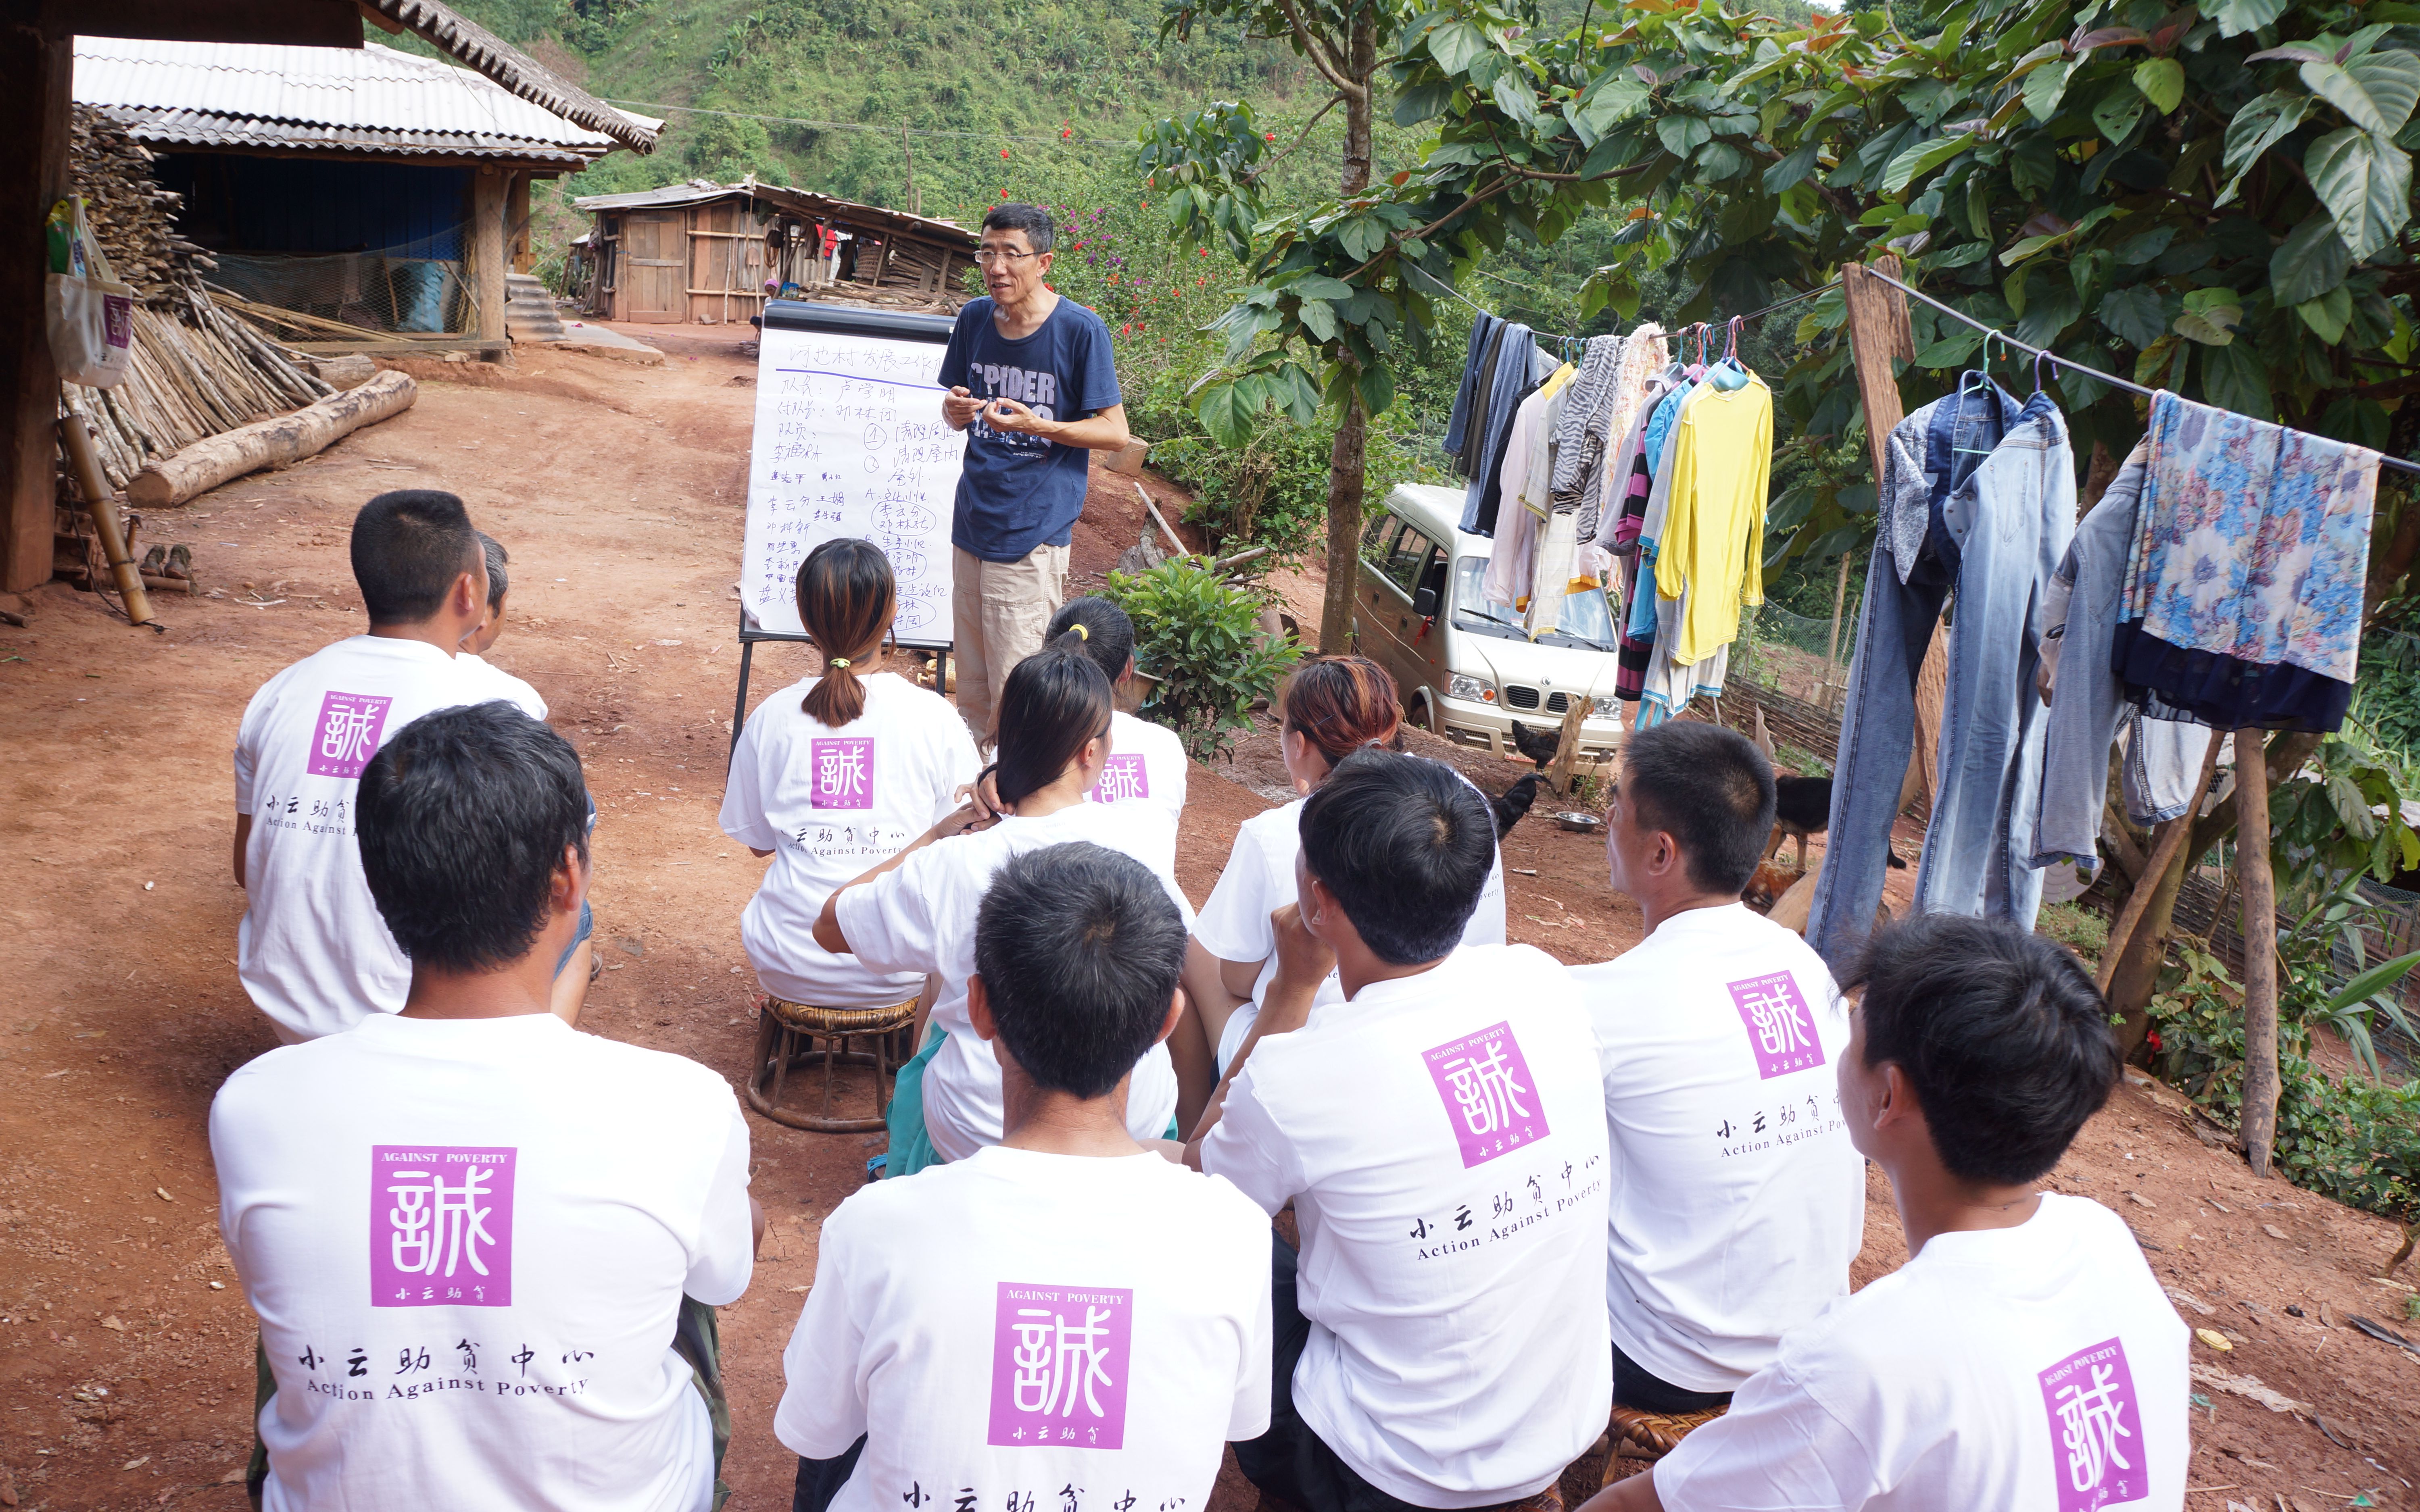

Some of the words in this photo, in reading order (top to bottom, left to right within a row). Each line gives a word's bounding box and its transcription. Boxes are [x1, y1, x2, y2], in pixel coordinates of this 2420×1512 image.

[970, 362, 1056, 405] SPIDER
[266, 817, 297, 829] Action
[302, 821, 346, 834] Against
[811, 847, 855, 857] Against
[1479, 888, 1499, 900] overty
[1733, 981, 1759, 992] AGAINST
[1761, 974, 1789, 985] POVERTY
[1430, 1043, 1465, 1062] AGAINST
[1468, 1027, 1506, 1048] POVERTY
[1720, 1141, 1770, 1158] Action
[1776, 1124, 1823, 1146] Against
[381, 1152, 439, 1163] AGAINST
[446, 1153, 508, 1164] POVERTY
[1410, 1155, 1599, 1239] 小云助贫中心
[1417, 1238, 1481, 1261] Action
[1489, 1206, 1549, 1243] Against
[1556, 1178, 1601, 1212] Poverty
[1006, 1290, 1060, 1302] AGAINST
[1066, 1293, 1124, 1305] POVERTY
[298, 1338, 595, 1378] 小云助贫中心
[306, 1379, 374, 1400] Action
[386, 1377, 485, 1400] Against
[496, 1378, 589, 1395] Poverty
